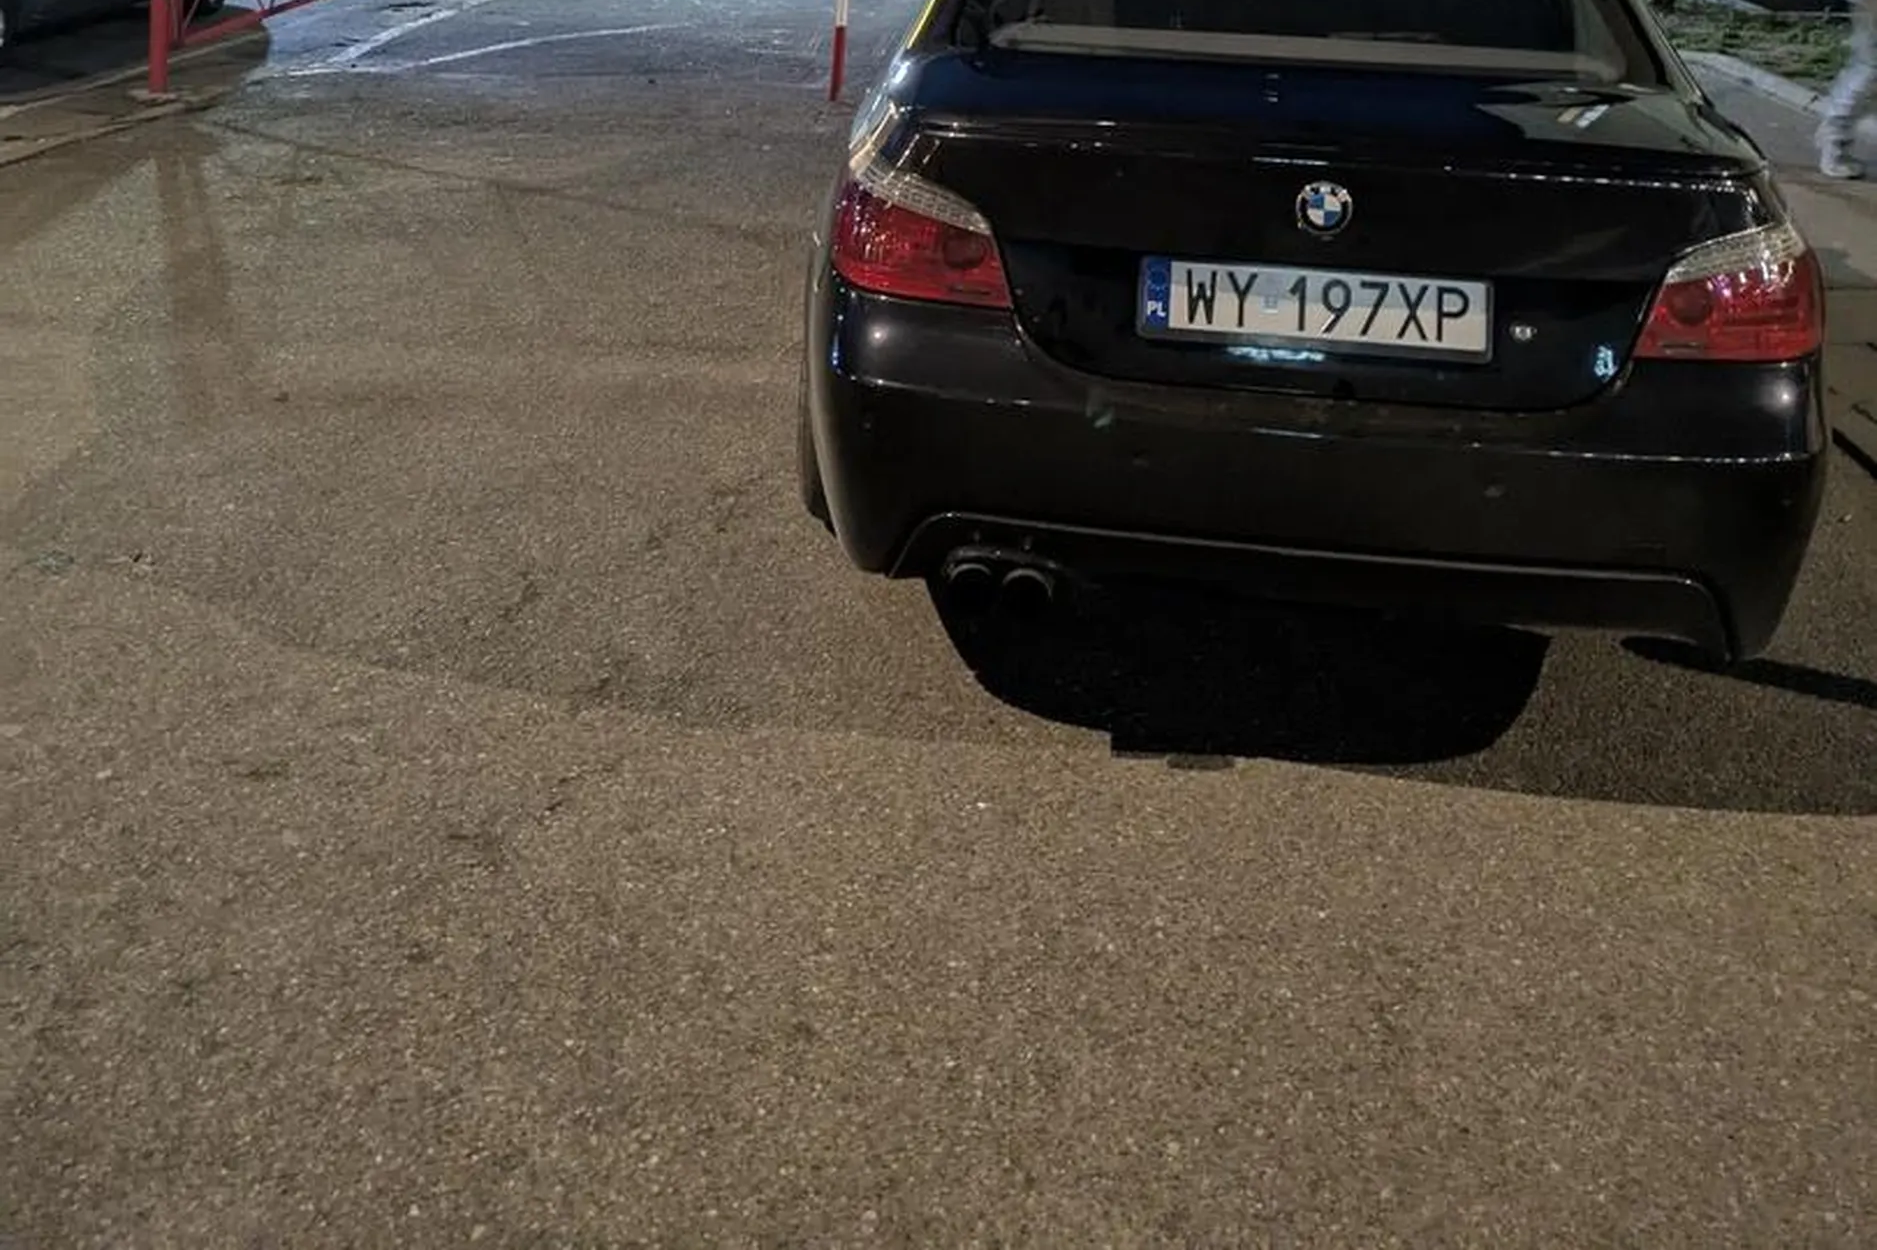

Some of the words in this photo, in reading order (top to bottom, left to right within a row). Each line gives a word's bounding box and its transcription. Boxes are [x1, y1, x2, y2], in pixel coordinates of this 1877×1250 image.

[1147, 300, 1167, 318] PL
[1186, 268, 1259, 328] WY
[1288, 275, 1470, 343] 197XP
